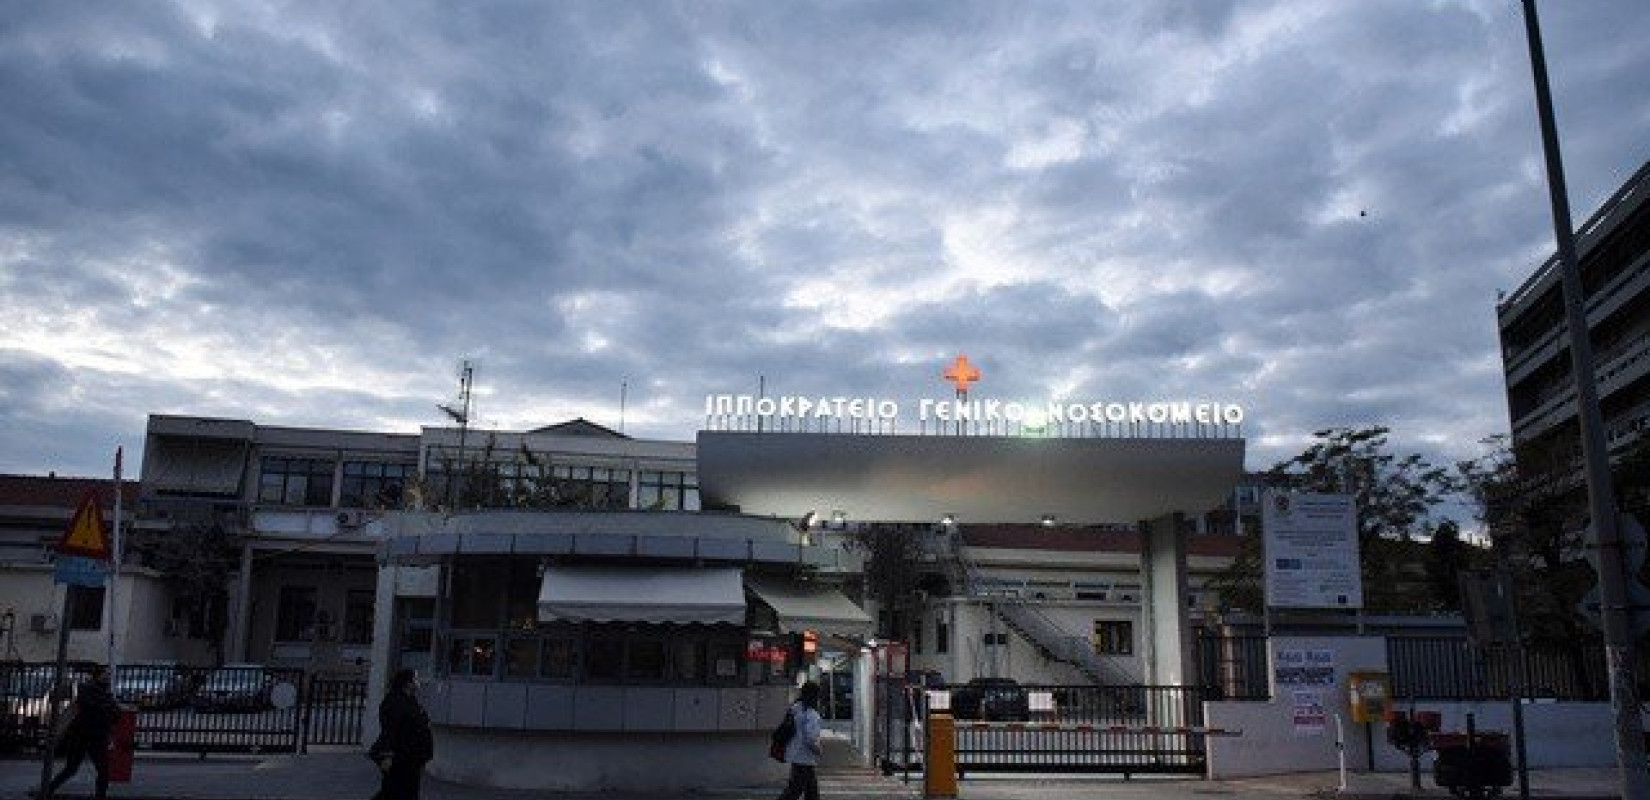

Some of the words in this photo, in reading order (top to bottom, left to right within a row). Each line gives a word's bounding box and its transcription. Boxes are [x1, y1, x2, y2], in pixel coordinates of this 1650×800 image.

[706, 395, 899, 418] ΙΠΠΟΚΡΑΤΕΙΟ
[920, 400, 1024, 421] ΓΕΝΙΚΟ
[1048, 401, 1243, 423] ΝΟΣΟΚΟΜΕΙΟ
